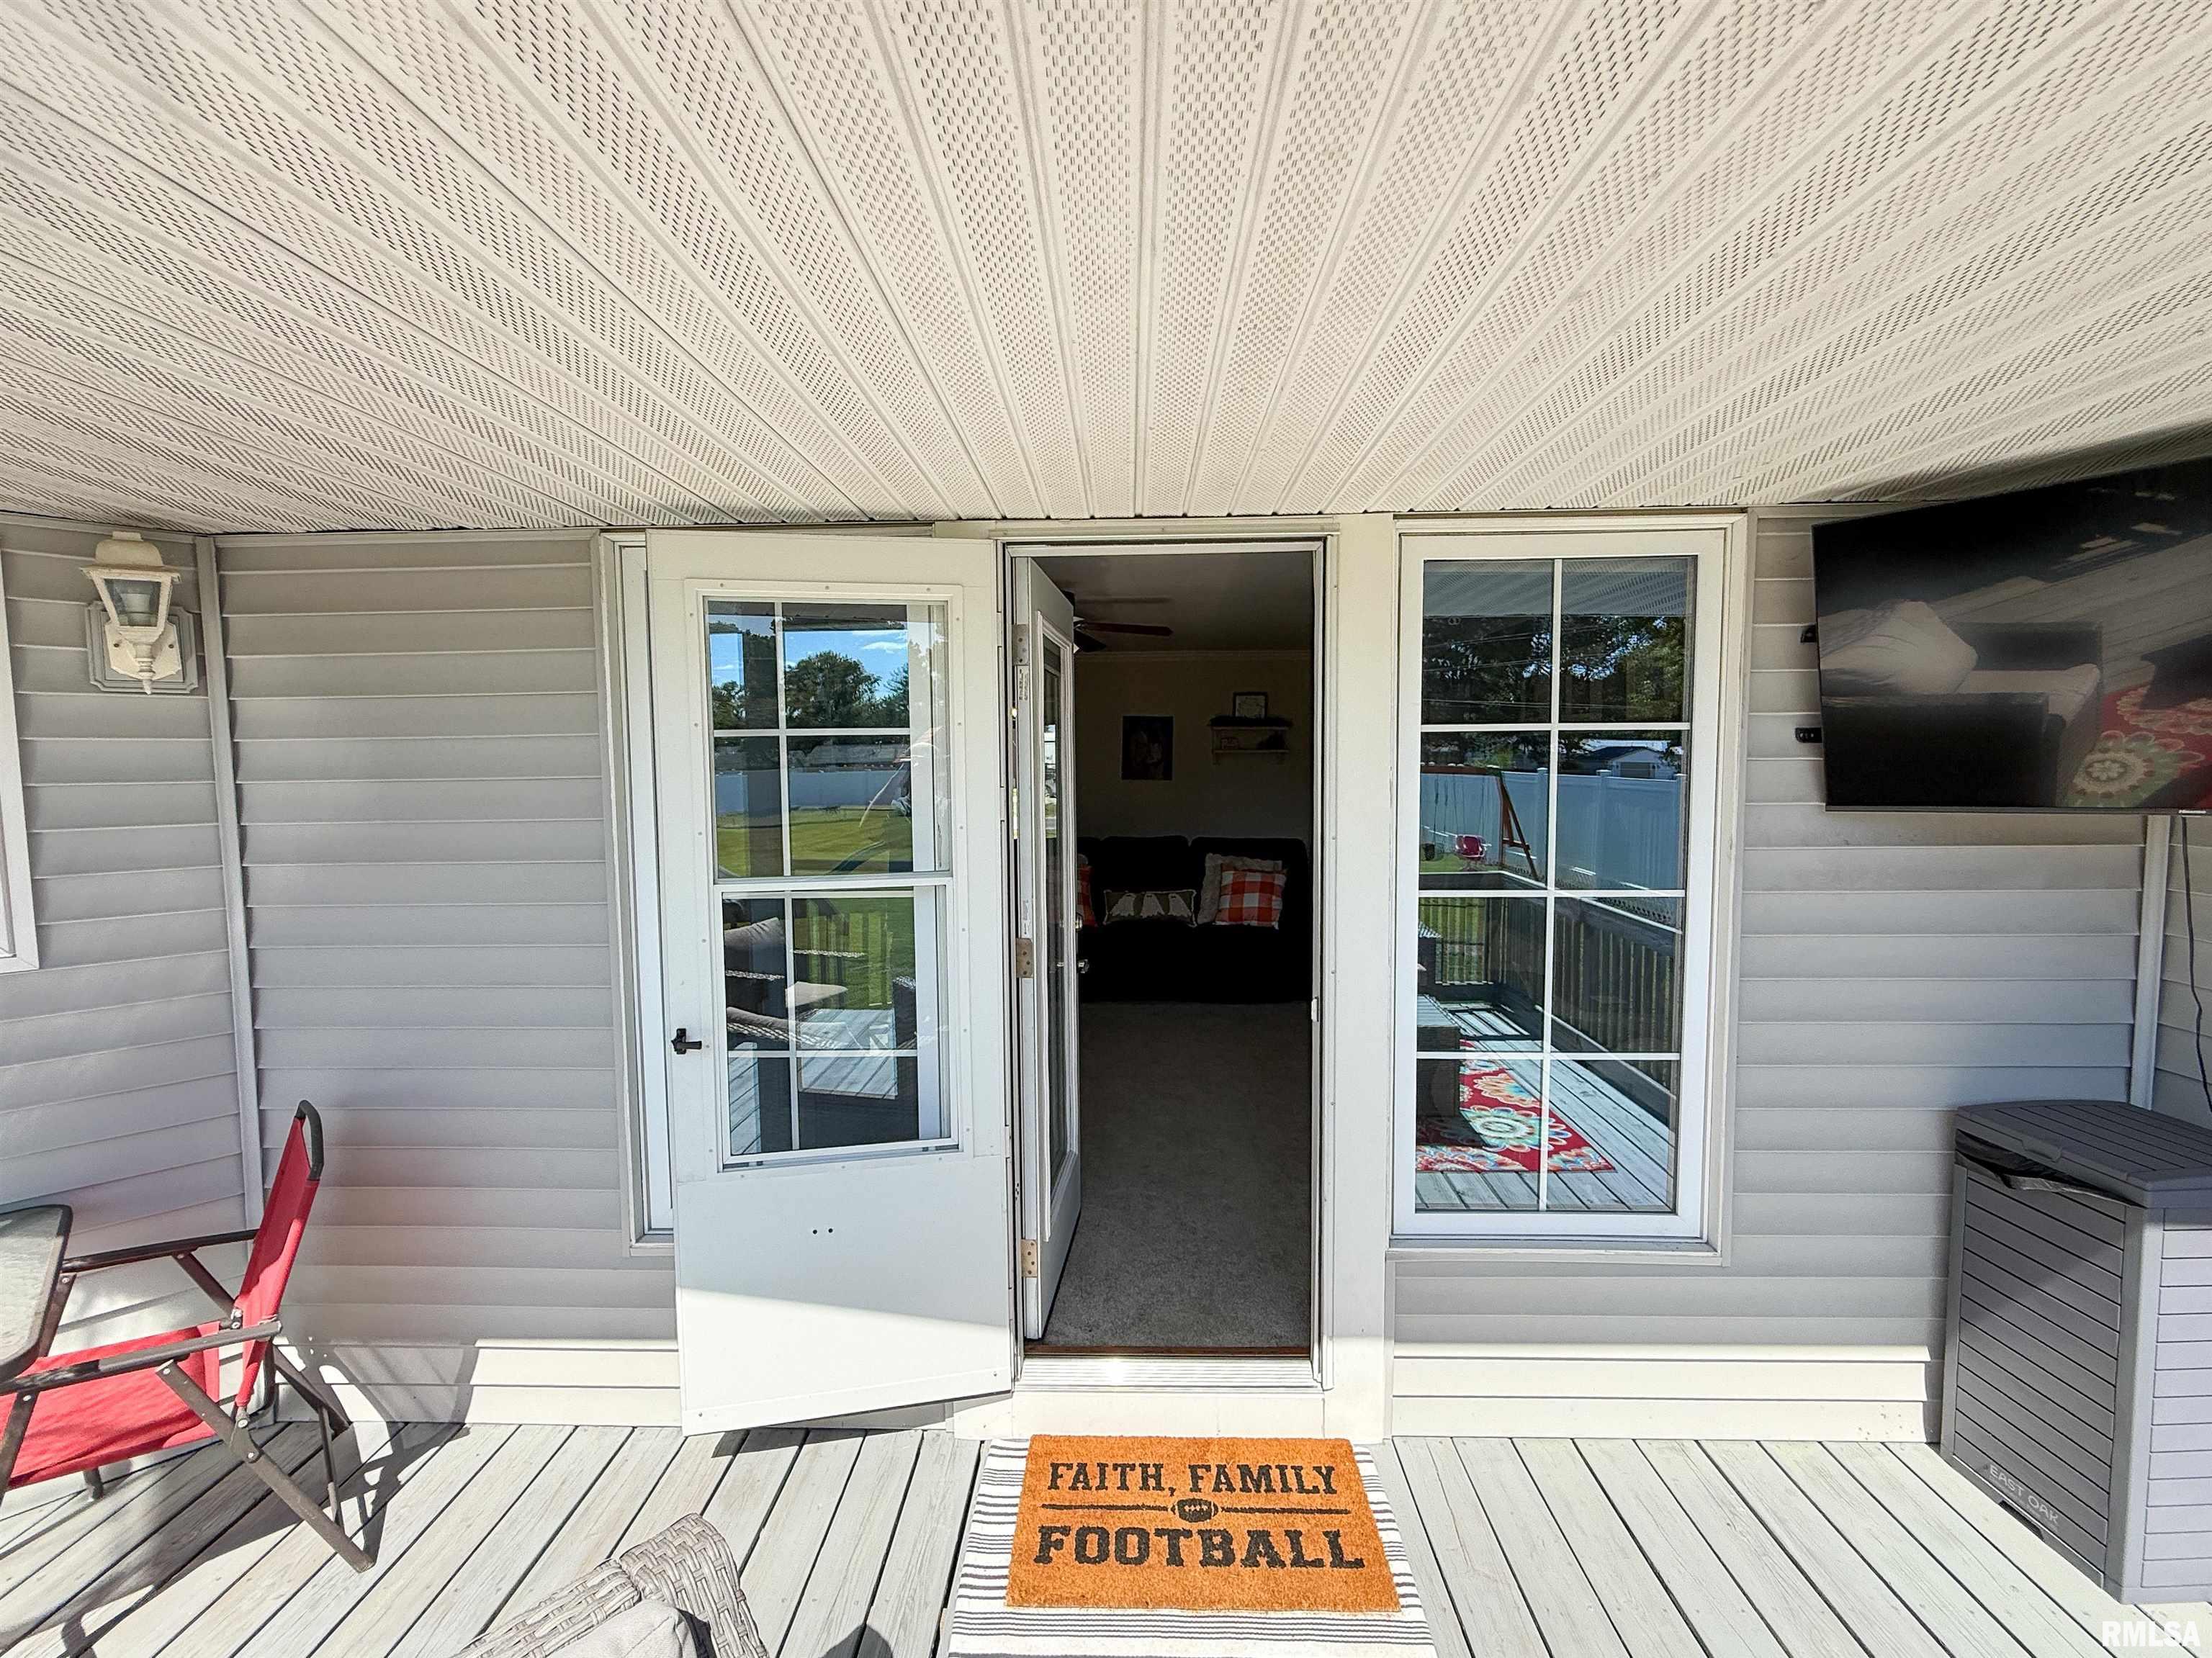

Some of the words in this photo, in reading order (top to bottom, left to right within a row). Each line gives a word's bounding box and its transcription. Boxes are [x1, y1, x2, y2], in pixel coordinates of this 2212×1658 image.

[1047, 1461, 1177, 1496] FAITH,
[1190, 1464, 1338, 1495] FAMILY
[1990, 1464, 2025, 1497] EAST
[2028, 1495, 2059, 1525] OAK
[1033, 1525, 1366, 1569] FOOTBALL
